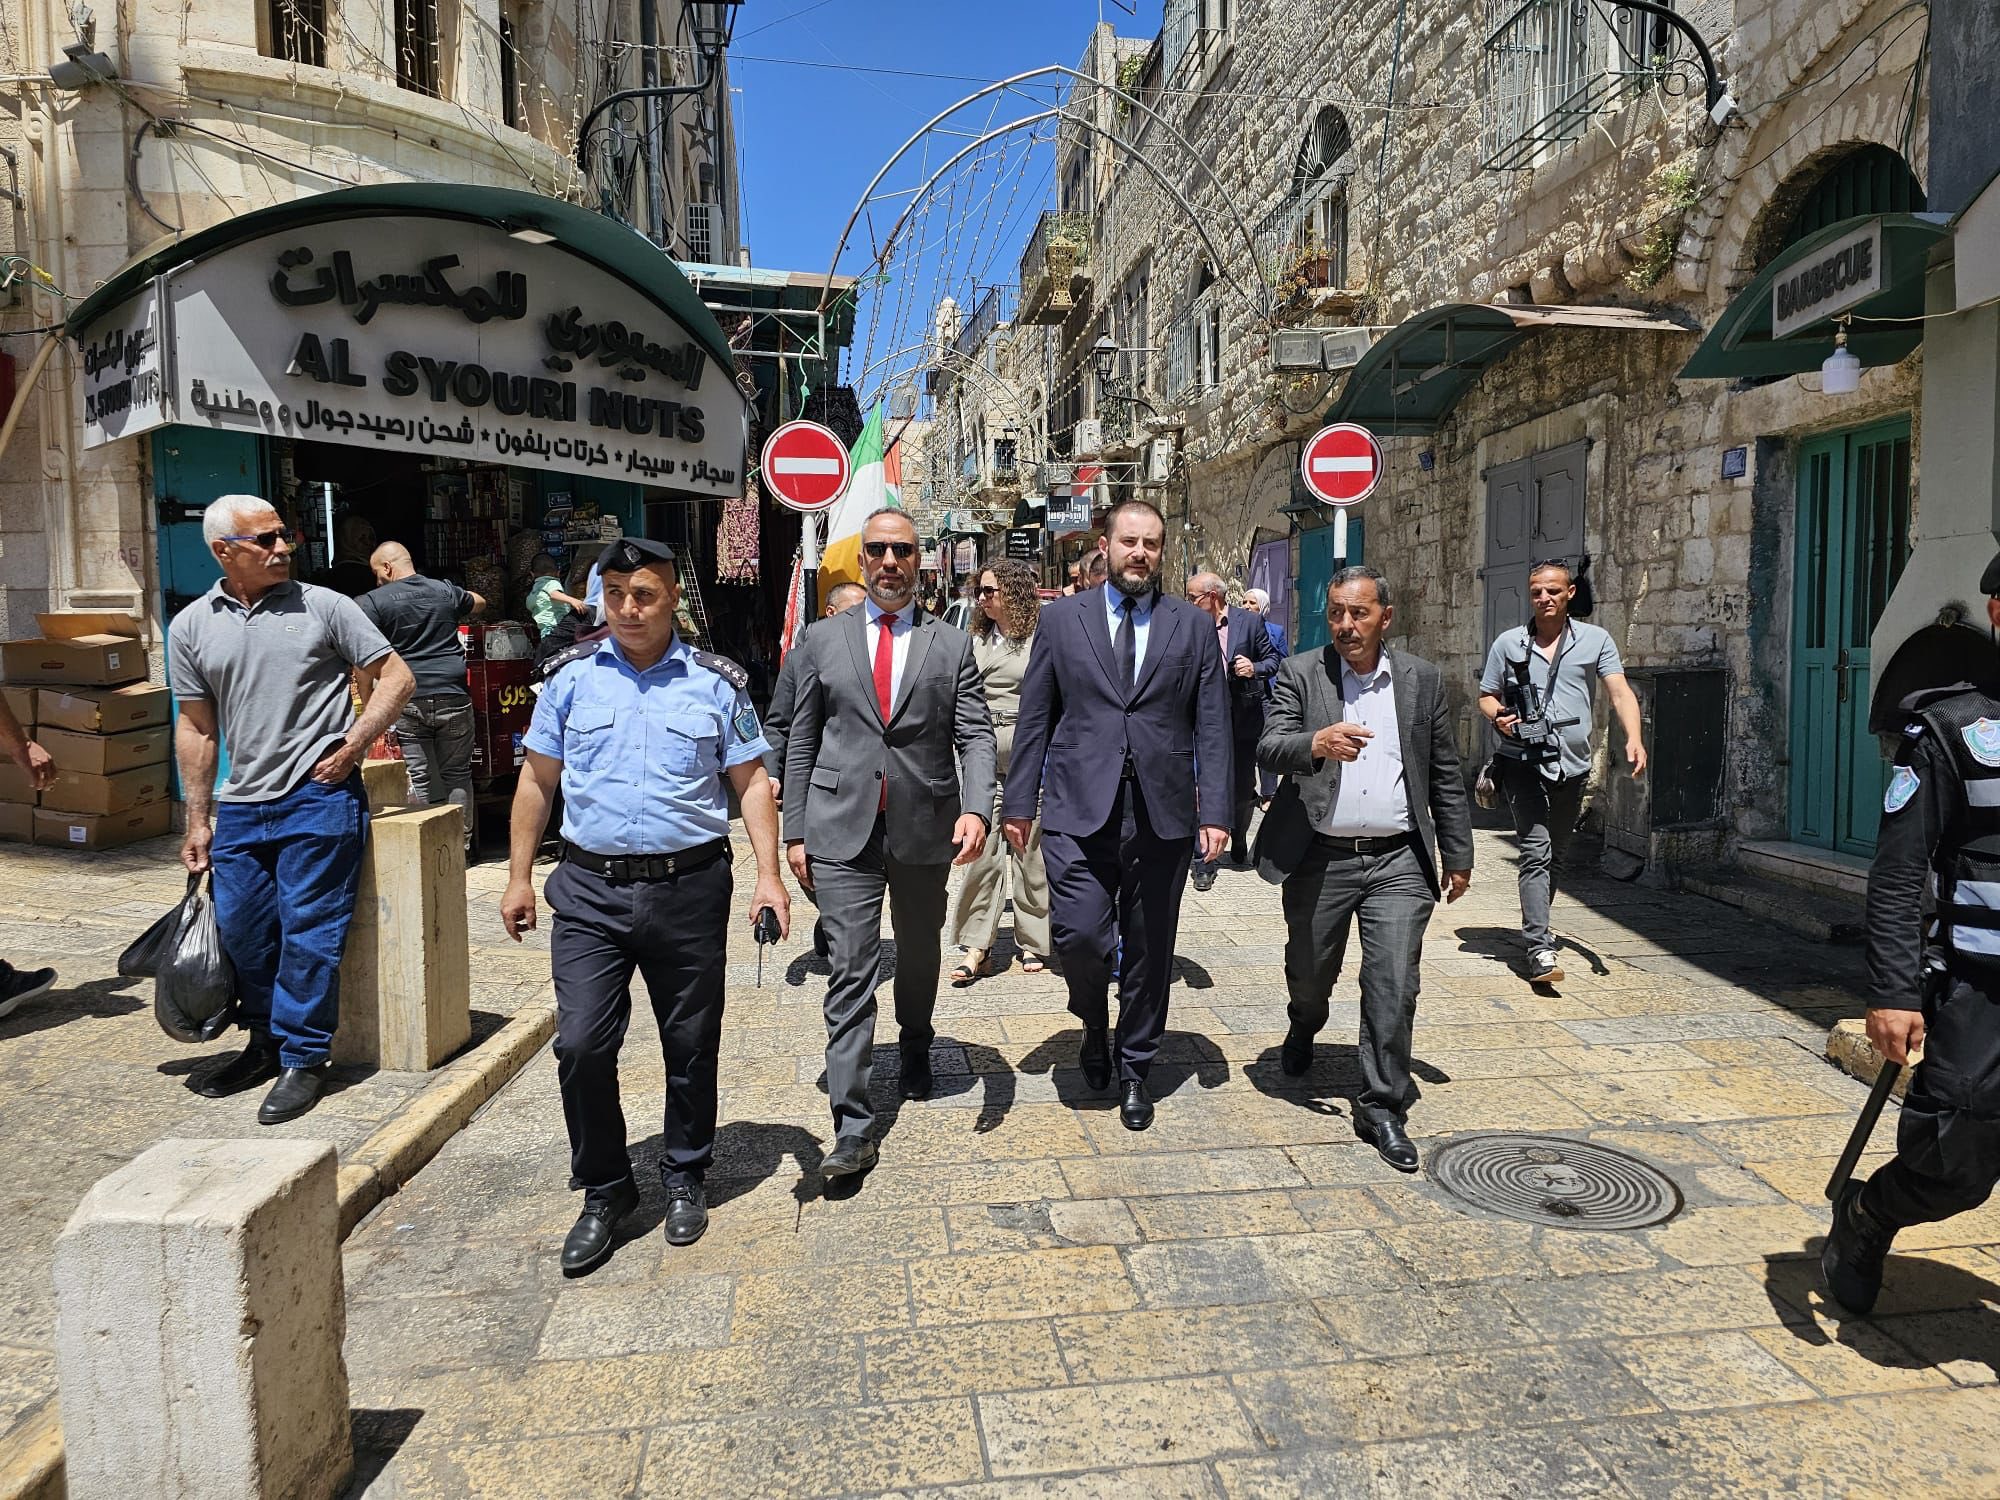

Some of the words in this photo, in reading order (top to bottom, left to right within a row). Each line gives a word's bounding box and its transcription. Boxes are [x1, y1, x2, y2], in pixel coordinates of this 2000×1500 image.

[269, 246, 527, 325] للمكسرات
[1777, 237, 1873, 321] BARBECUE
[285, 332, 367, 387] AL
[382, 351, 577, 421] SYOURI
[590, 386, 705, 443] NUTS
[295, 400, 355, 435] جوال
[356, 413, 414, 441] رصيد
[418, 416, 474, 444] شحن
[495, 427, 550, 461] بلفون
[553, 438, 608, 466] كرتات
[625, 449, 675, 477] سيجار
[690, 459, 735, 486] سجائر
